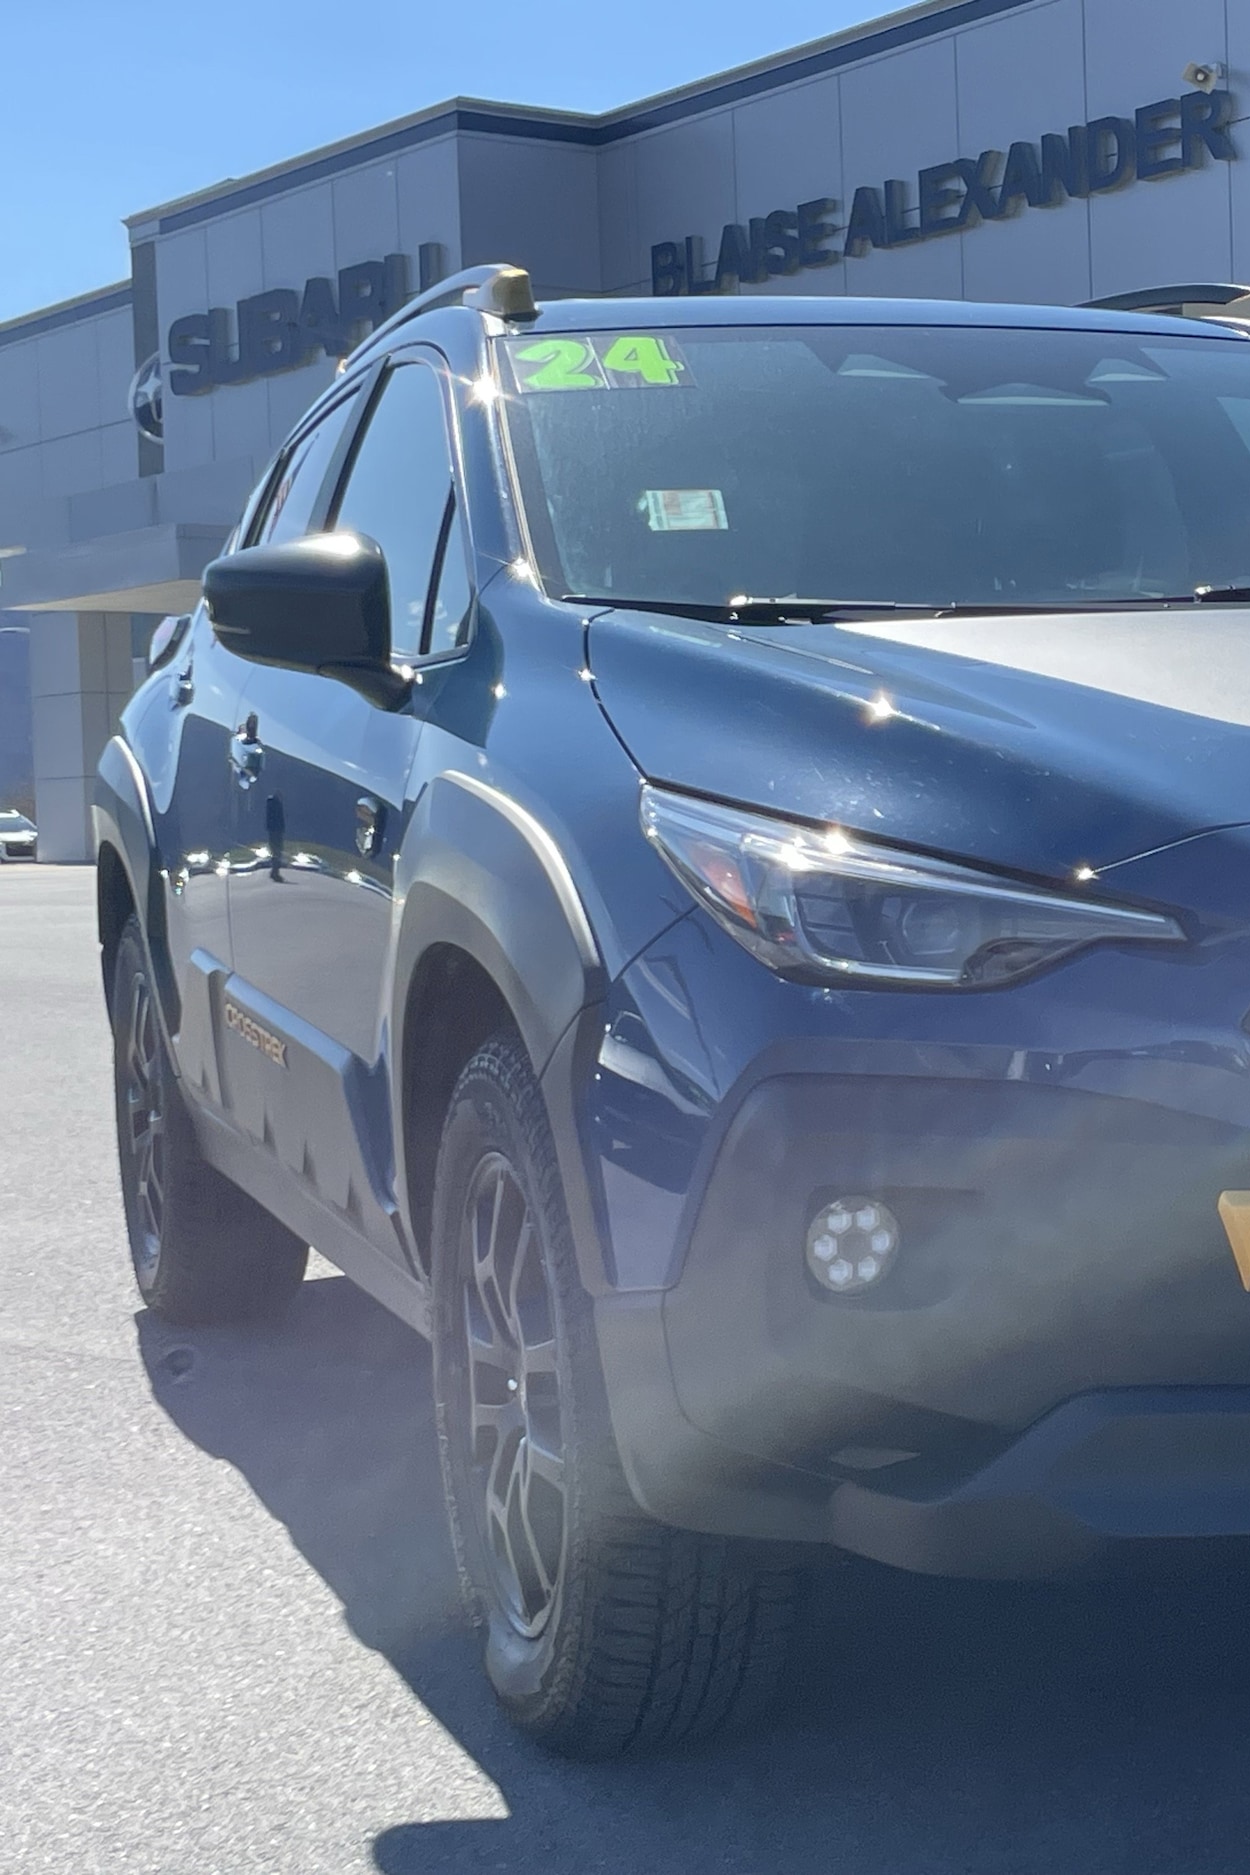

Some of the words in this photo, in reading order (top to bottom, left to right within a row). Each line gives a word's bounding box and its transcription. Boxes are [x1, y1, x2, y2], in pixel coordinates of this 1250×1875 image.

[651, 197, 839, 297] BLAISE
[844, 89, 1237, 258] ALEXANDER
[514, 336, 684, 389] 24
